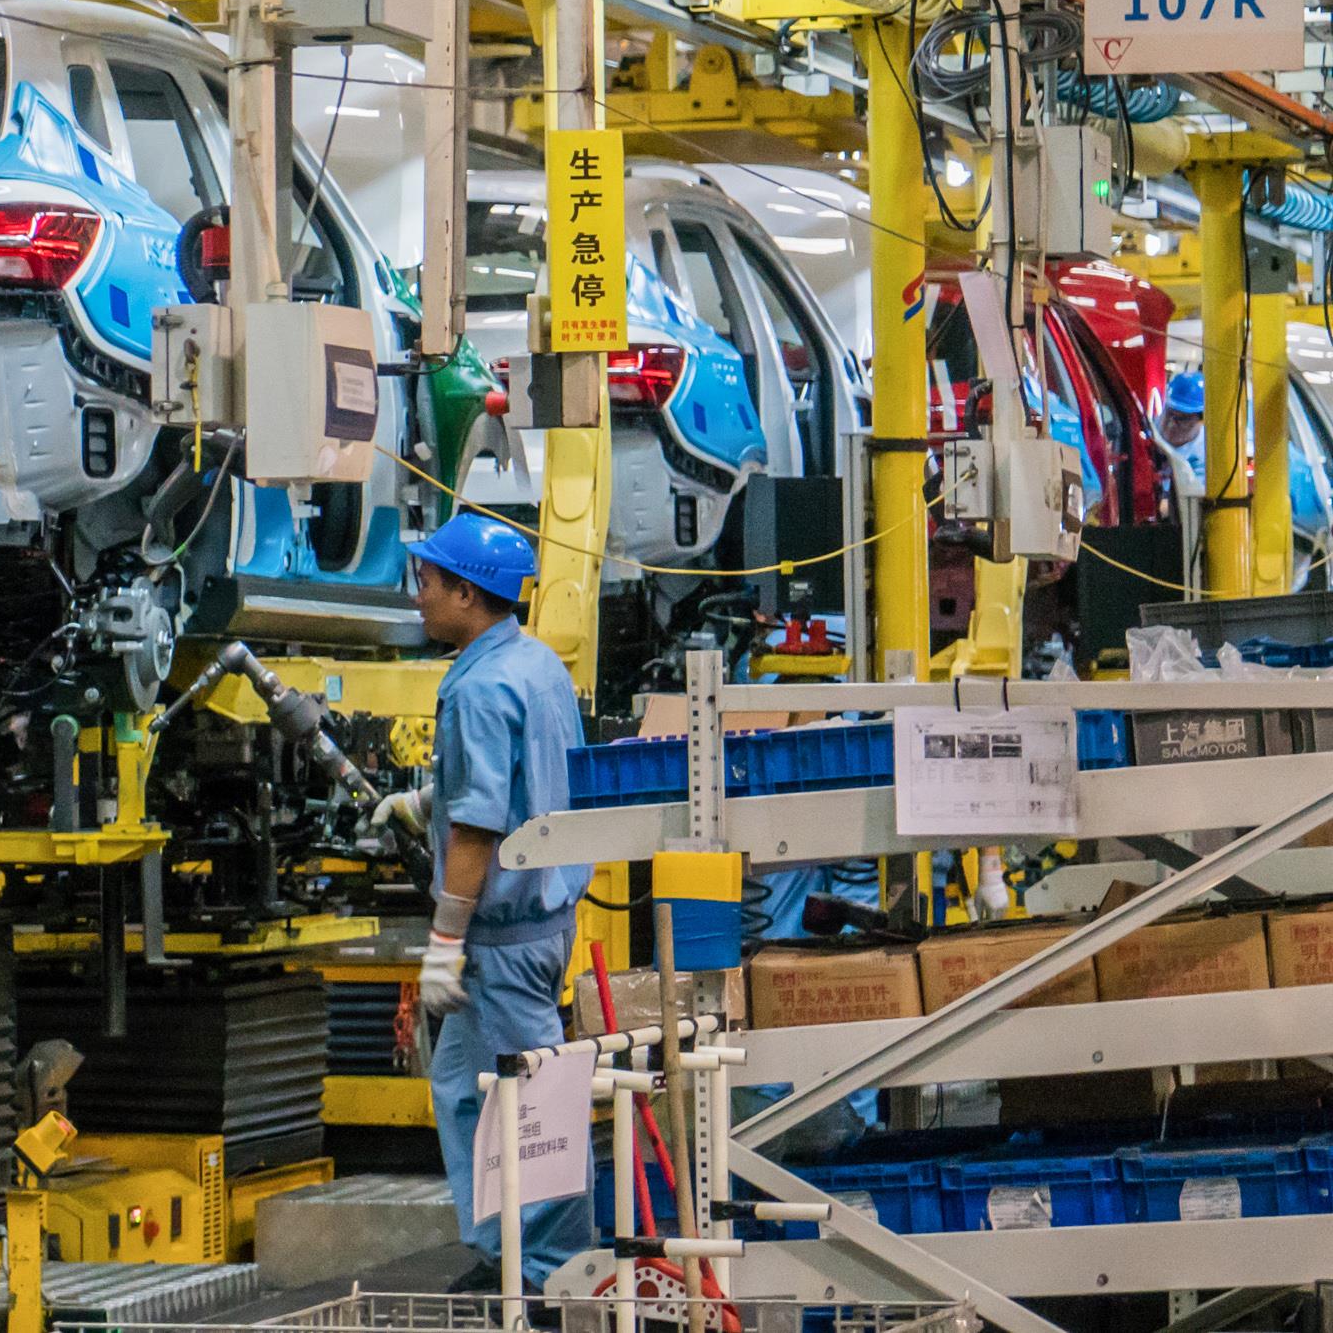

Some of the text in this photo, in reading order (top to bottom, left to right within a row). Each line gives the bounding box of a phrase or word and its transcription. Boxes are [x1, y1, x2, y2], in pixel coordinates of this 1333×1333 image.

[1103, 39, 1123, 61] C
[569, 148, 606, 307] 生产急停
[1197, 742, 1248, 756] MOTOR
